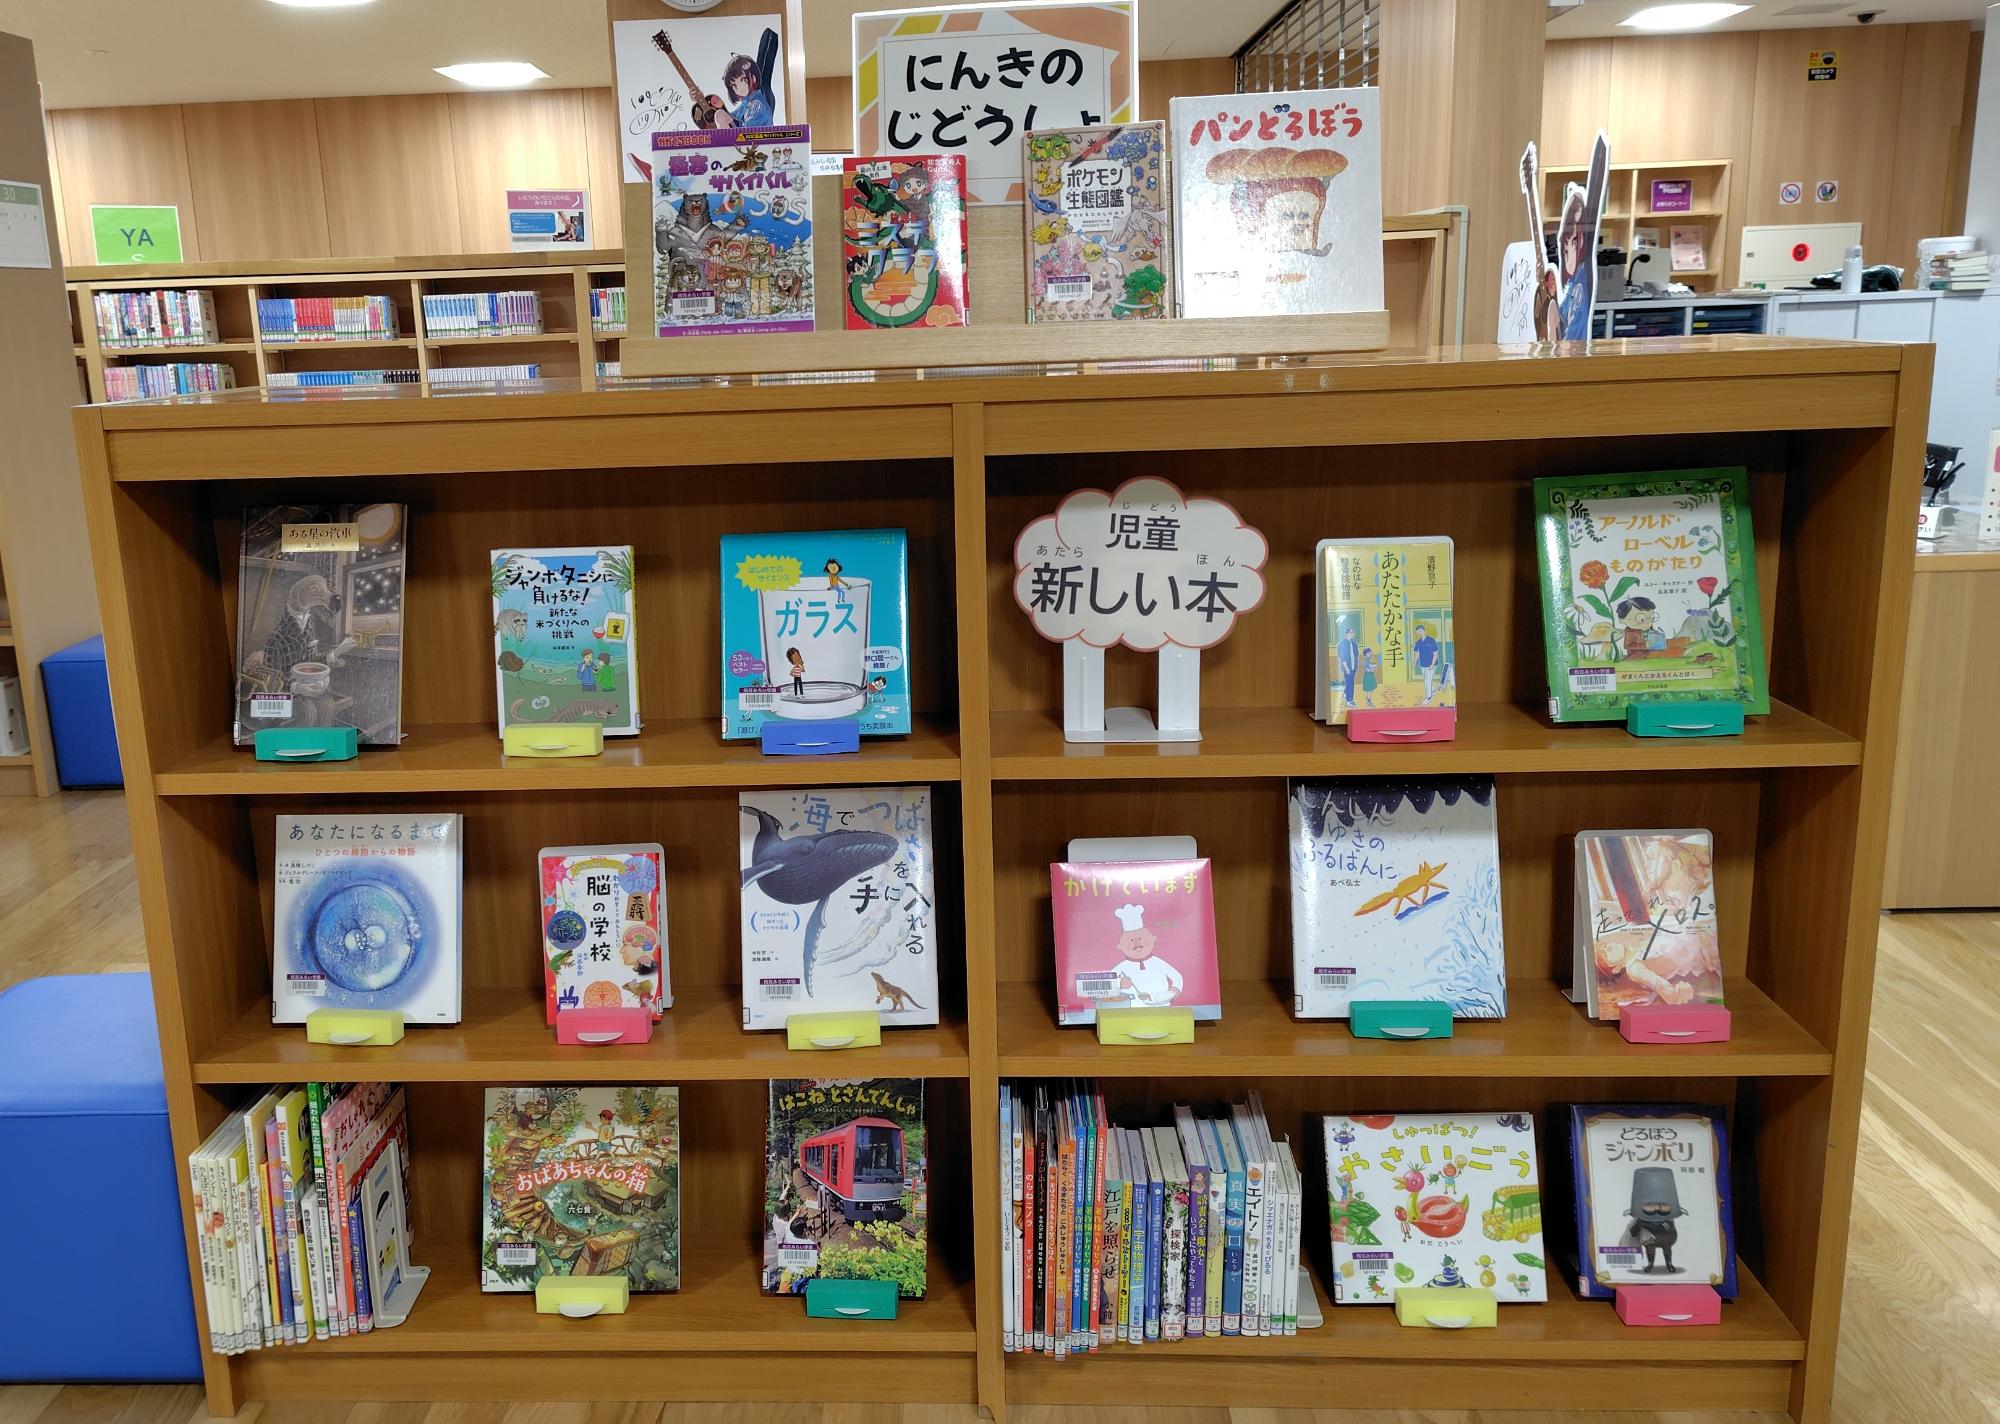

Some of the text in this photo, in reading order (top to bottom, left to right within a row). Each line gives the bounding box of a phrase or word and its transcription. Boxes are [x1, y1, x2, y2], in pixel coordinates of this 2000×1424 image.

[906, 46, 1084, 93] にんきの
[1190, 102, 1363, 147] パンどろぼう
[709, 171, 793, 193] サバイバル
[1067, 168, 1123, 188] ポケモン
[1066, 189, 1124, 210] 生態図鑑
[120, 228, 154, 247] YA
[857, 220, 930, 250] ミステ
[289, 526, 352, 541] ある星の汽車
[1105, 512, 1181, 552] 児童
[1623, 534, 1696, 552] ローベル
[1036, 544, 1084, 558] あたら
[1196, 553, 1235, 568] ほん
[1610, 556, 1704, 574] ものがたり
[505, 564, 613, 591] ジャンボタニシに
[1352, 557, 1362, 590] なのはな
[533, 586, 590, 606] 負けるな！
[1029, 562, 1239, 623] 新しい本
[536, 619, 590, 629] 米づくりへの
[549, 608, 578, 618] 新たな
[775, 598, 858, 639] ガラス
[1381, 551, 1404, 668] あたたかな手
[552, 630, 575, 640] 挑戦
[1327, 822, 1386, 852] ゆきの
[1329, 878, 1361, 888] あべ弘士
[586, 874, 612, 962] 脳の学校
[779, 1087, 917, 1116] はこねとざんでんしゃ
[1620, 1126, 1678, 1142] どろぼう
[517, 1160, 649, 1194] おばあちゃんの箱
[1338, 1145, 1531, 1180] やさいごう
[1228, 1180, 1244, 1247] 真実の口
[1101, 1188, 1121, 1279] 江戸を照らせ
[1196, 1194, 1208, 1266] 読書会を魔女と
[1169, 1229, 1182, 1262] 探検家
[1188, 1217, 1198, 1289] いっしょにやってみたら
